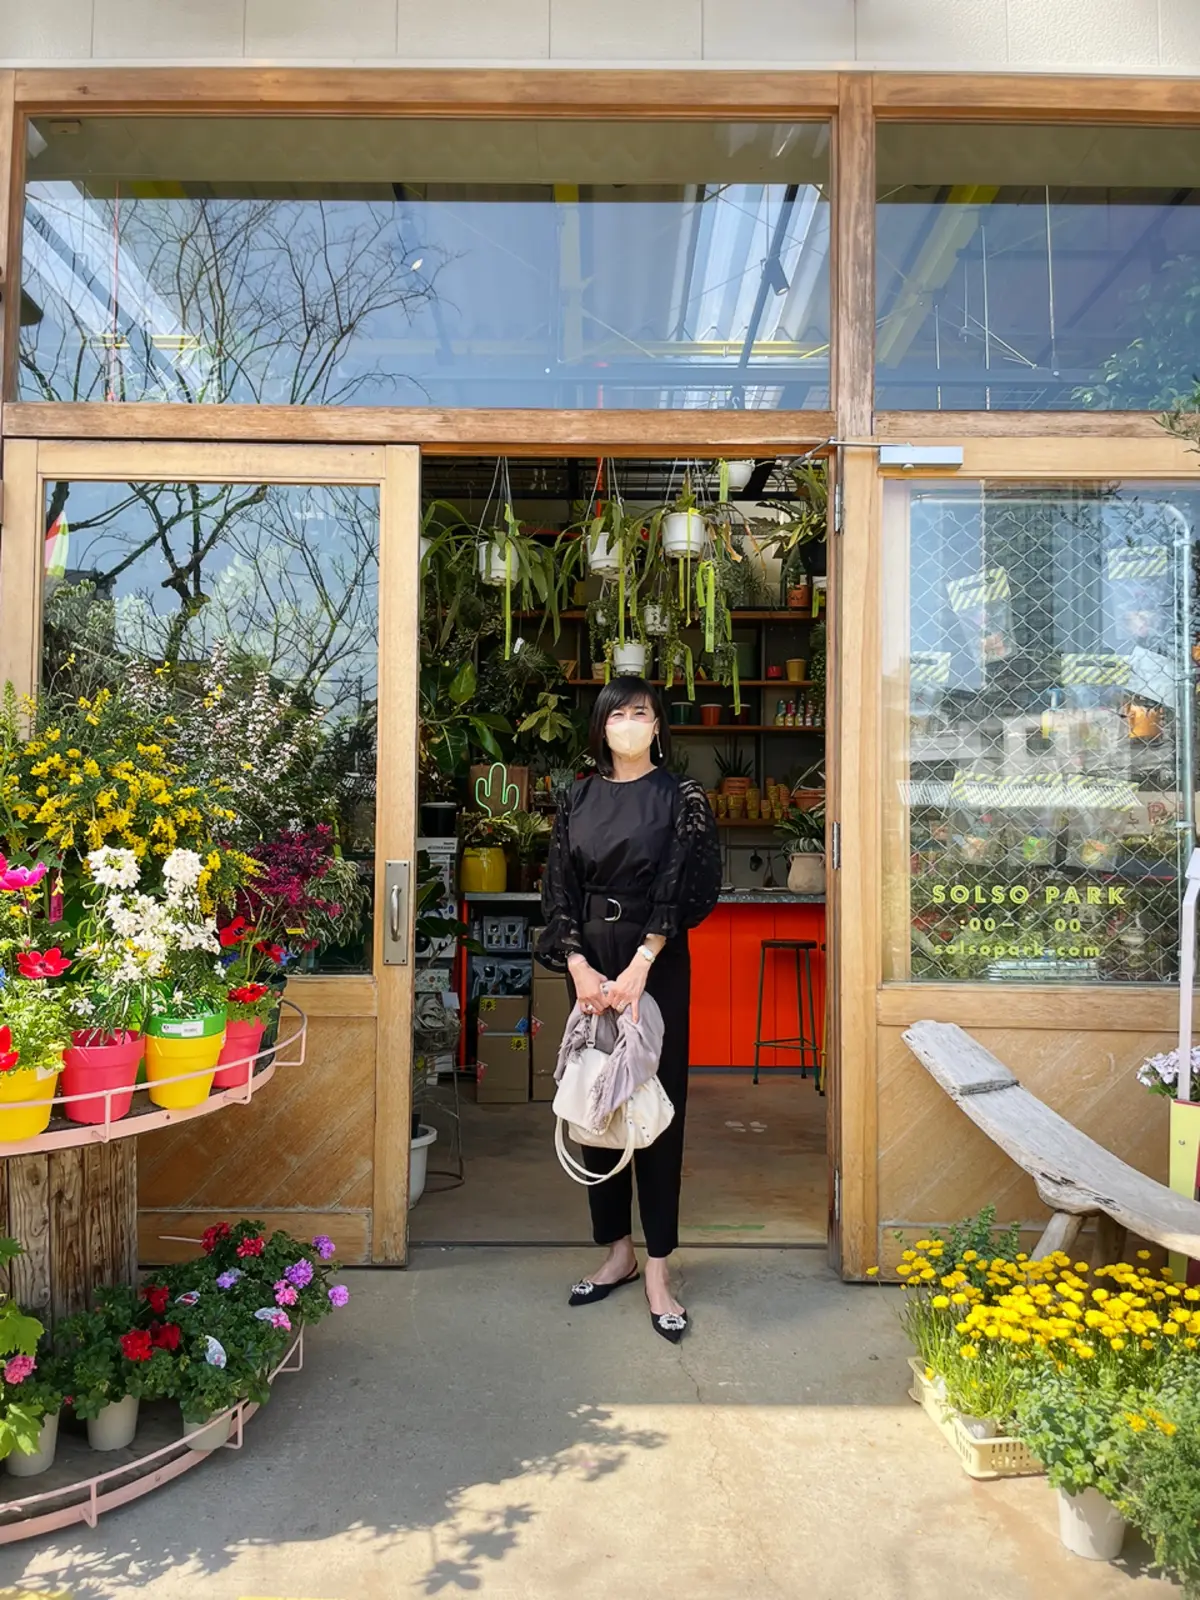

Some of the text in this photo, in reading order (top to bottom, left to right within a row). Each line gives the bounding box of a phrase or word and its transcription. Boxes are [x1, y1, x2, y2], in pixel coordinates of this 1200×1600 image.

[933, 885, 1126, 905] SOLSO PARK
[934, 940, 1100, 958] solsopark.com
